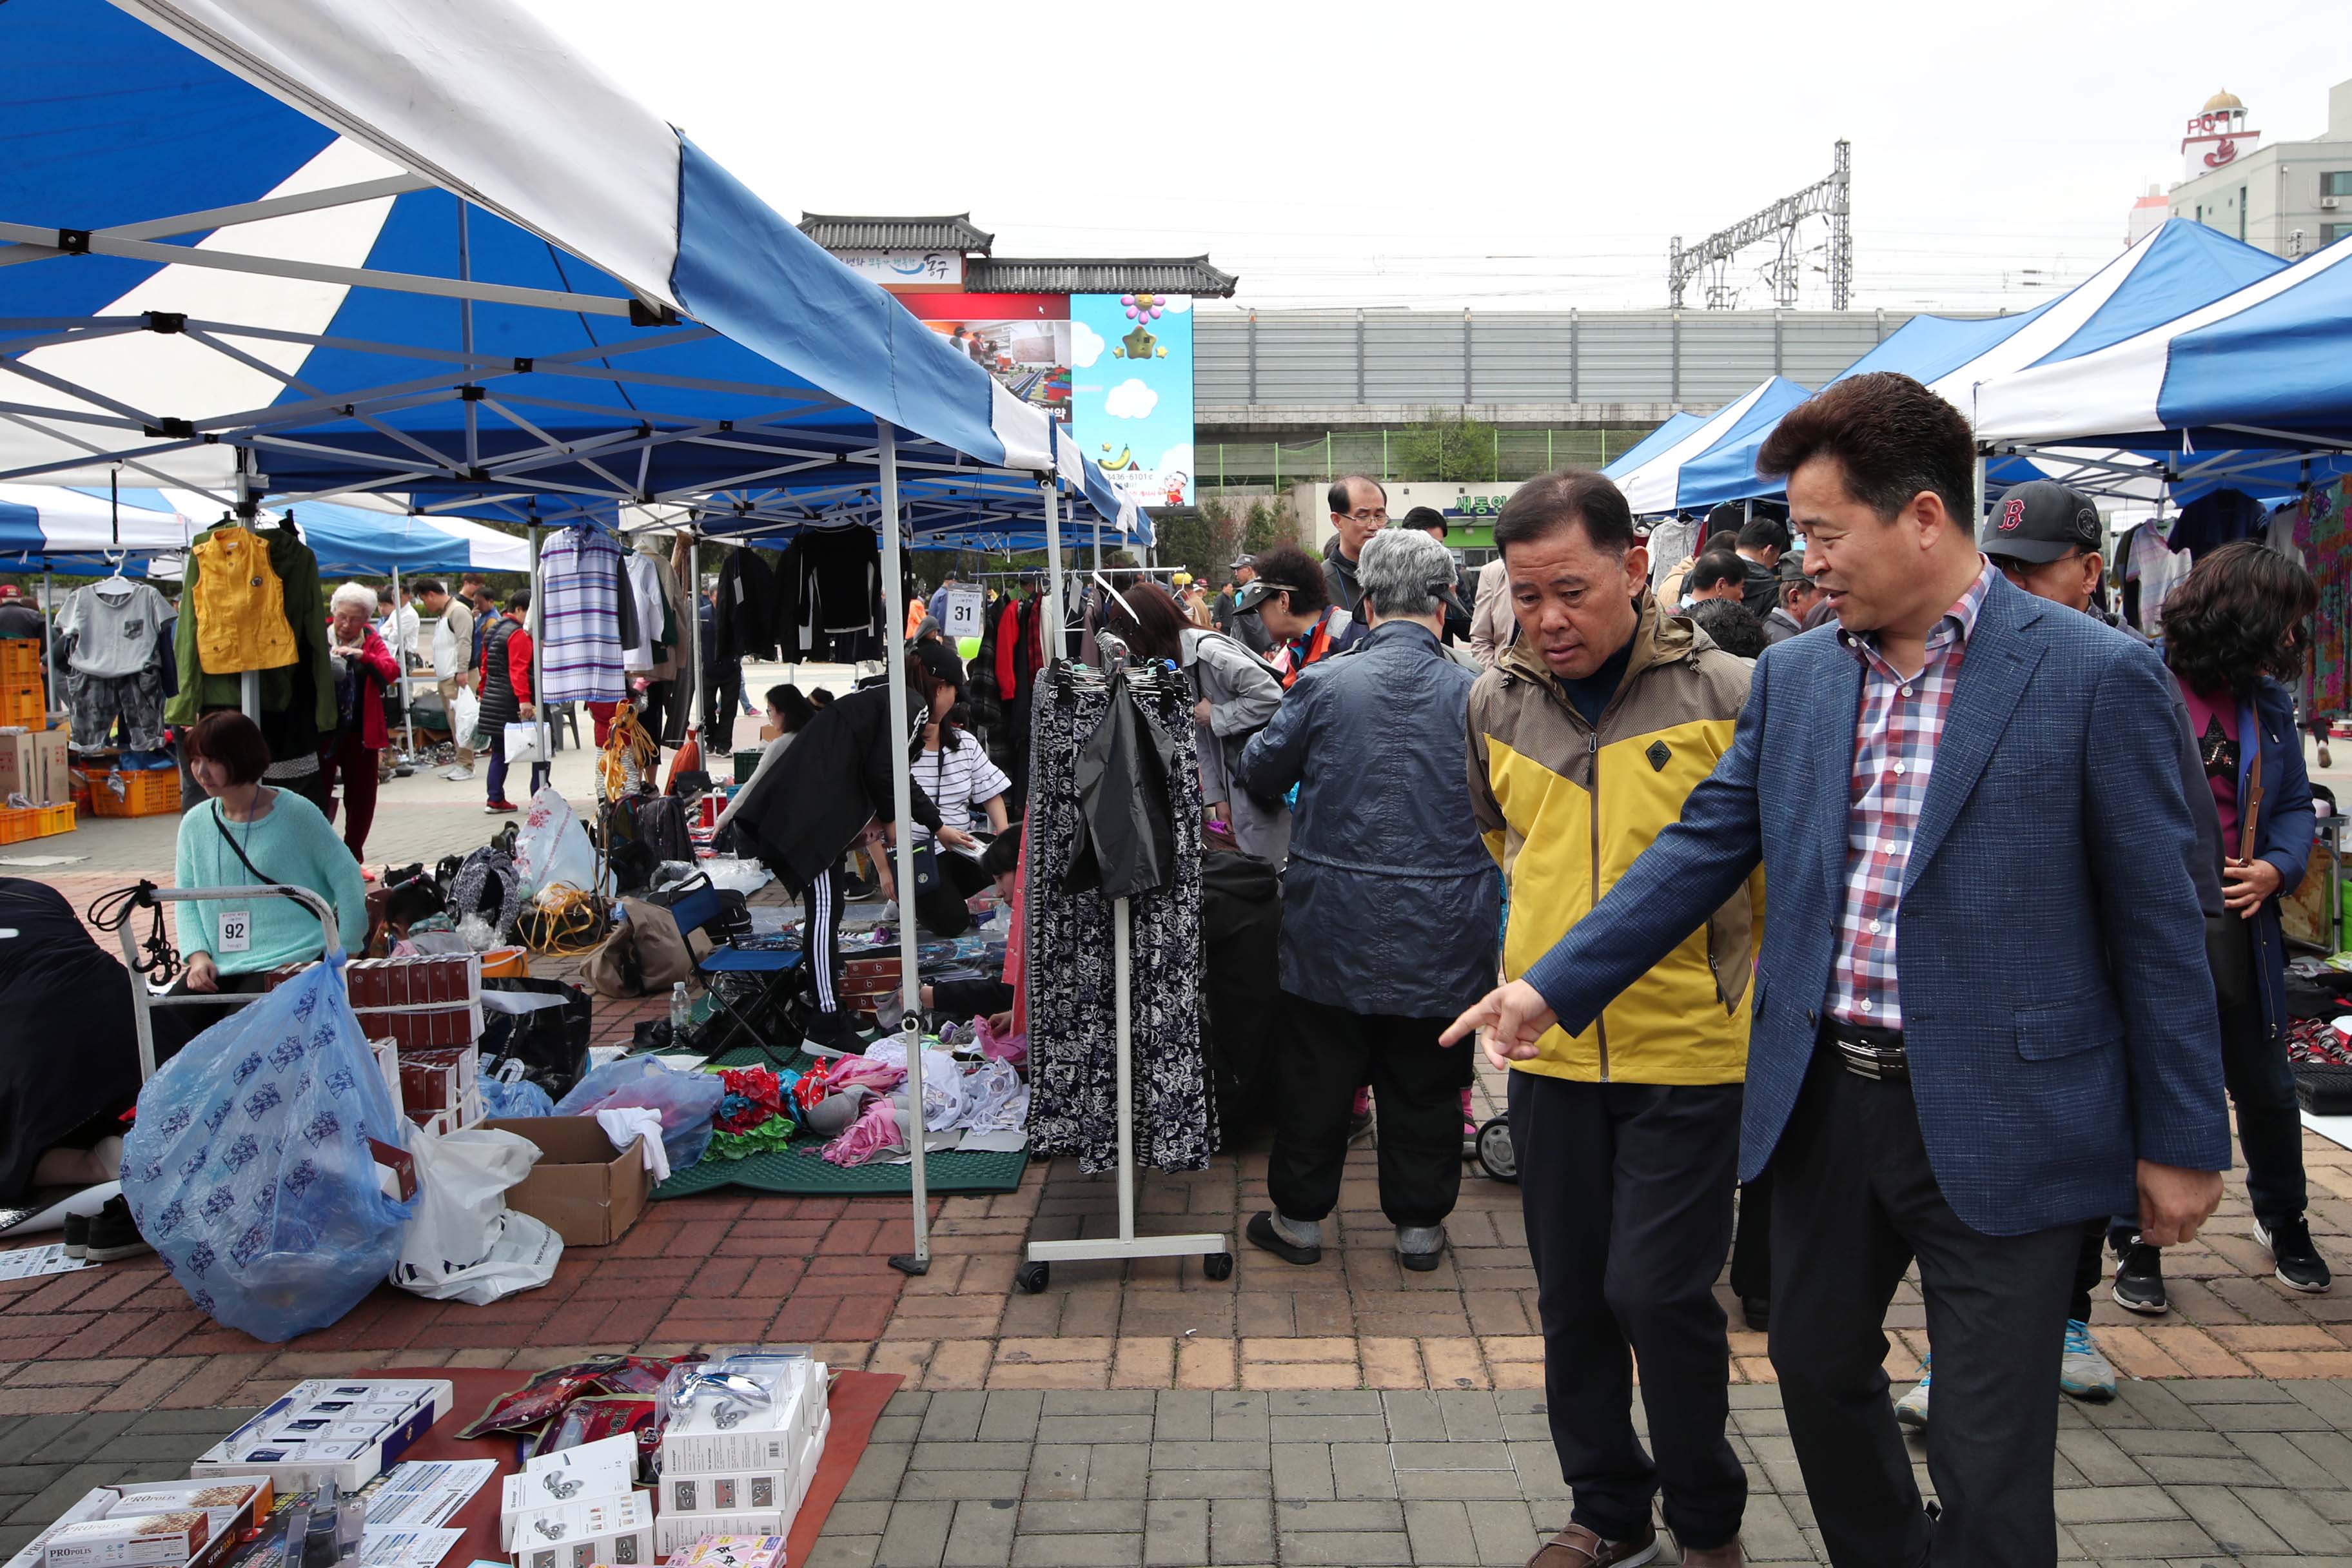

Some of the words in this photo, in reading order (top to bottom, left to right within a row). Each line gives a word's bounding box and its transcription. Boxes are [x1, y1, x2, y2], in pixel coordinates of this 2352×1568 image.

[923, 253, 949, 280] 동구
[1999, 499, 2025, 531] B
[955, 606, 971, 621] 31
[226, 923, 244, 939] 92
[63, 1524, 121, 1533] PROPOLIS
[50, 1548, 92, 1558] PROPOLIS
